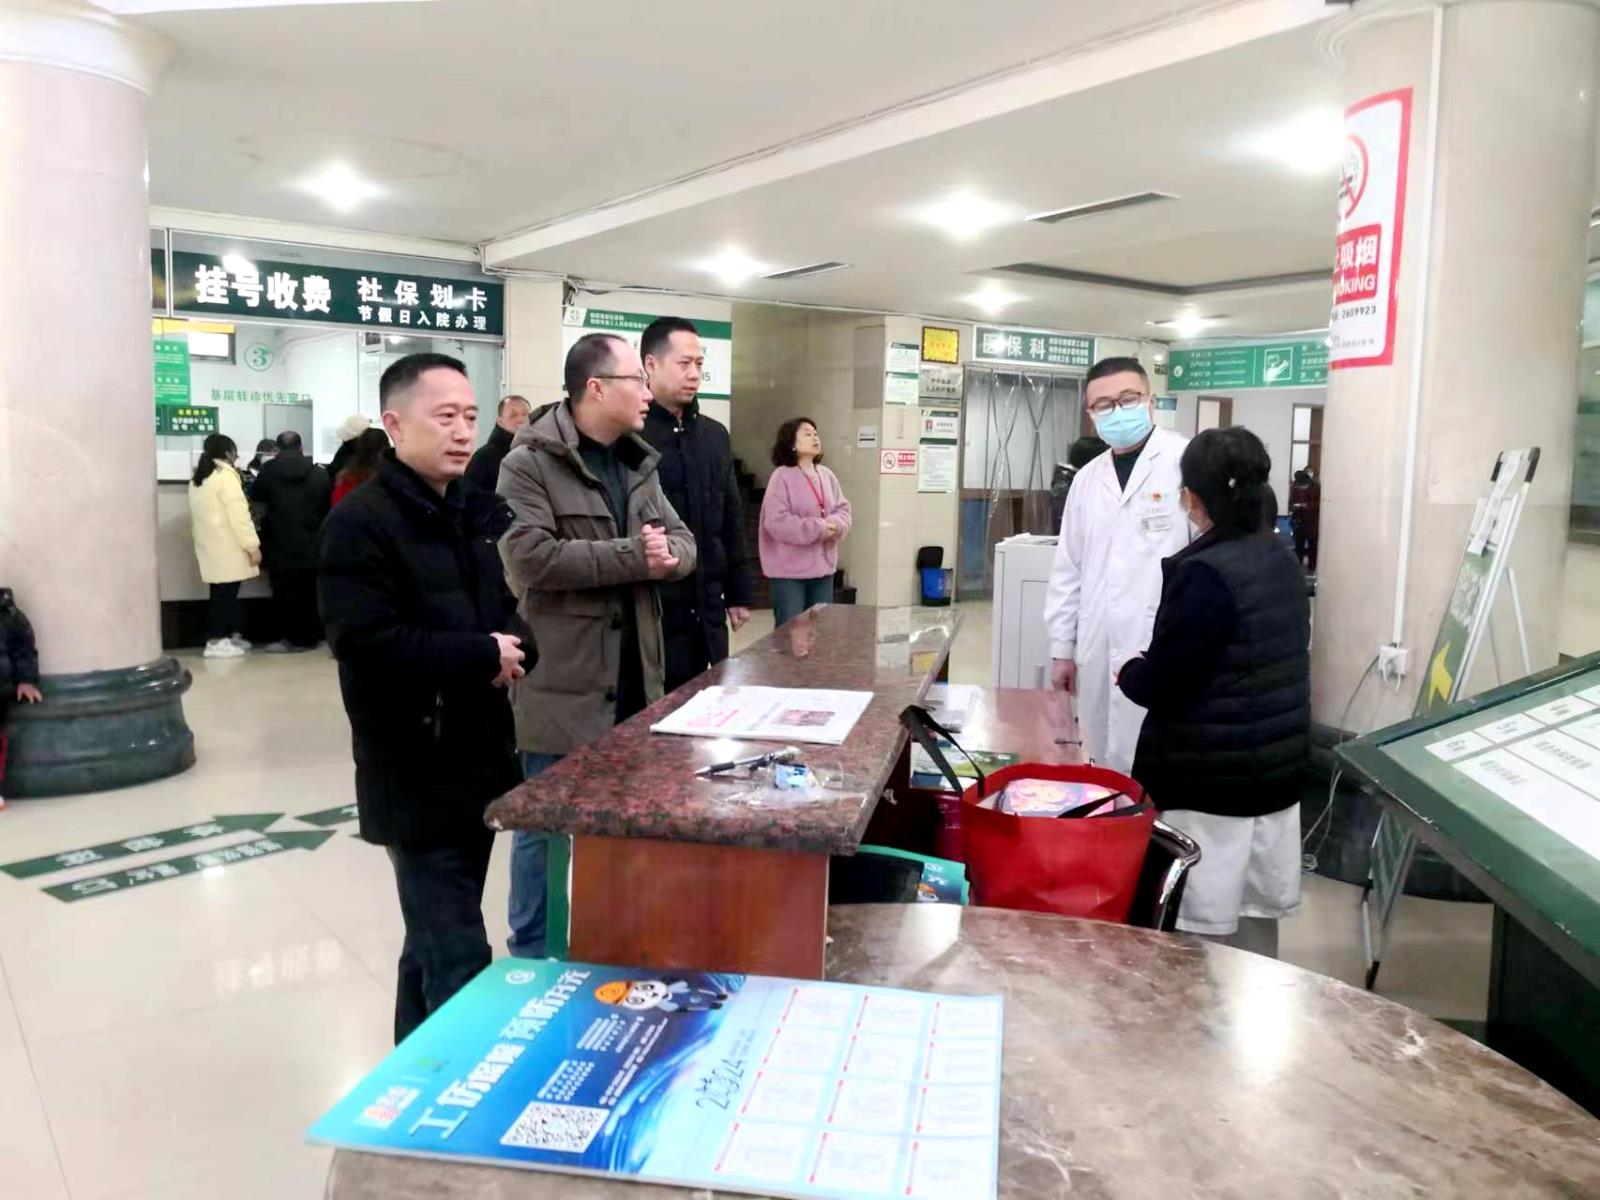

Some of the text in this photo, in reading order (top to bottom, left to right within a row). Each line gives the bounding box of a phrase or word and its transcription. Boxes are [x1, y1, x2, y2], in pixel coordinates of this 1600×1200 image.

[195, 263, 488, 314] 挂号收费 社保划卡
[357, 304, 488, 331] 节假日入院办理
[251, 346, 269, 367] 3
